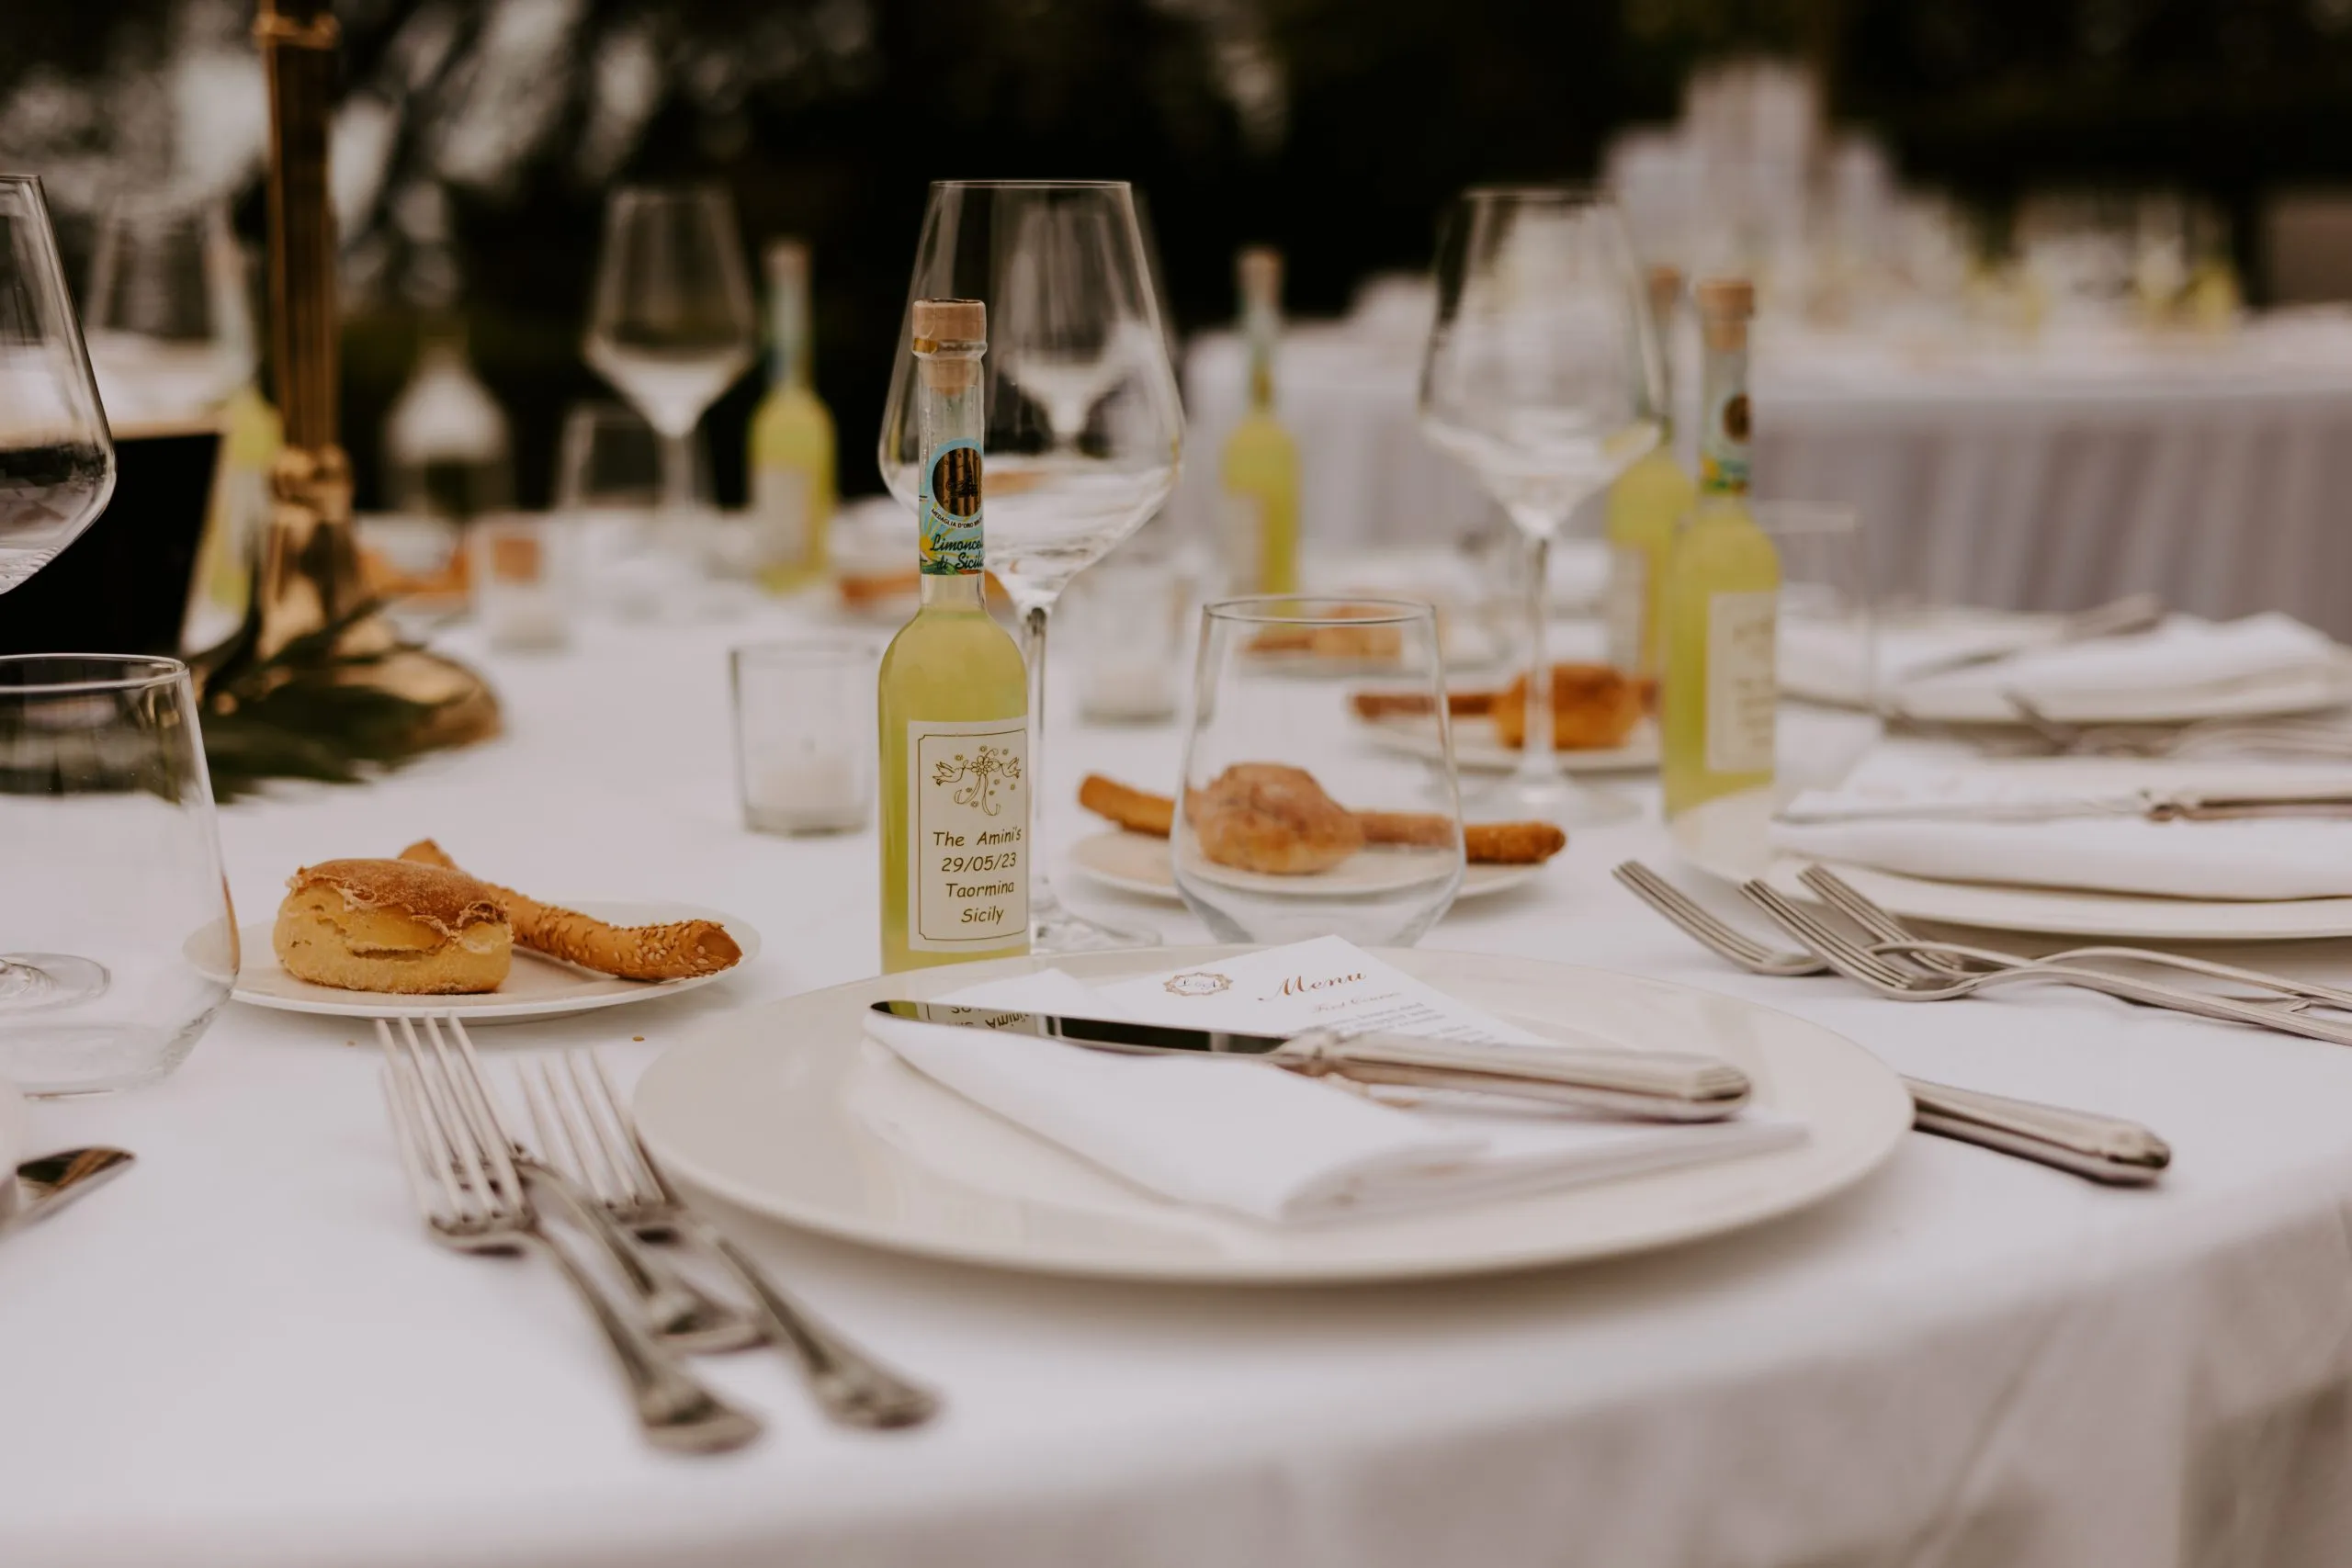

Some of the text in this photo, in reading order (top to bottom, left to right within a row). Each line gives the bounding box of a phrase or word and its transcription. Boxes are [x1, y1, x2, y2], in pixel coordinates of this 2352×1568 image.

[931, 508, 956, 527] MEDAGLIA
[937, 555, 949, 570] di
[933, 827, 1022, 848] The Amini's
[941, 852, 1017, 873] 29/05/23
[945, 880, 1014, 898] Taormina
[960, 905, 1004, 925] Sicily
[1258, 973, 1367, 1001] Menu
